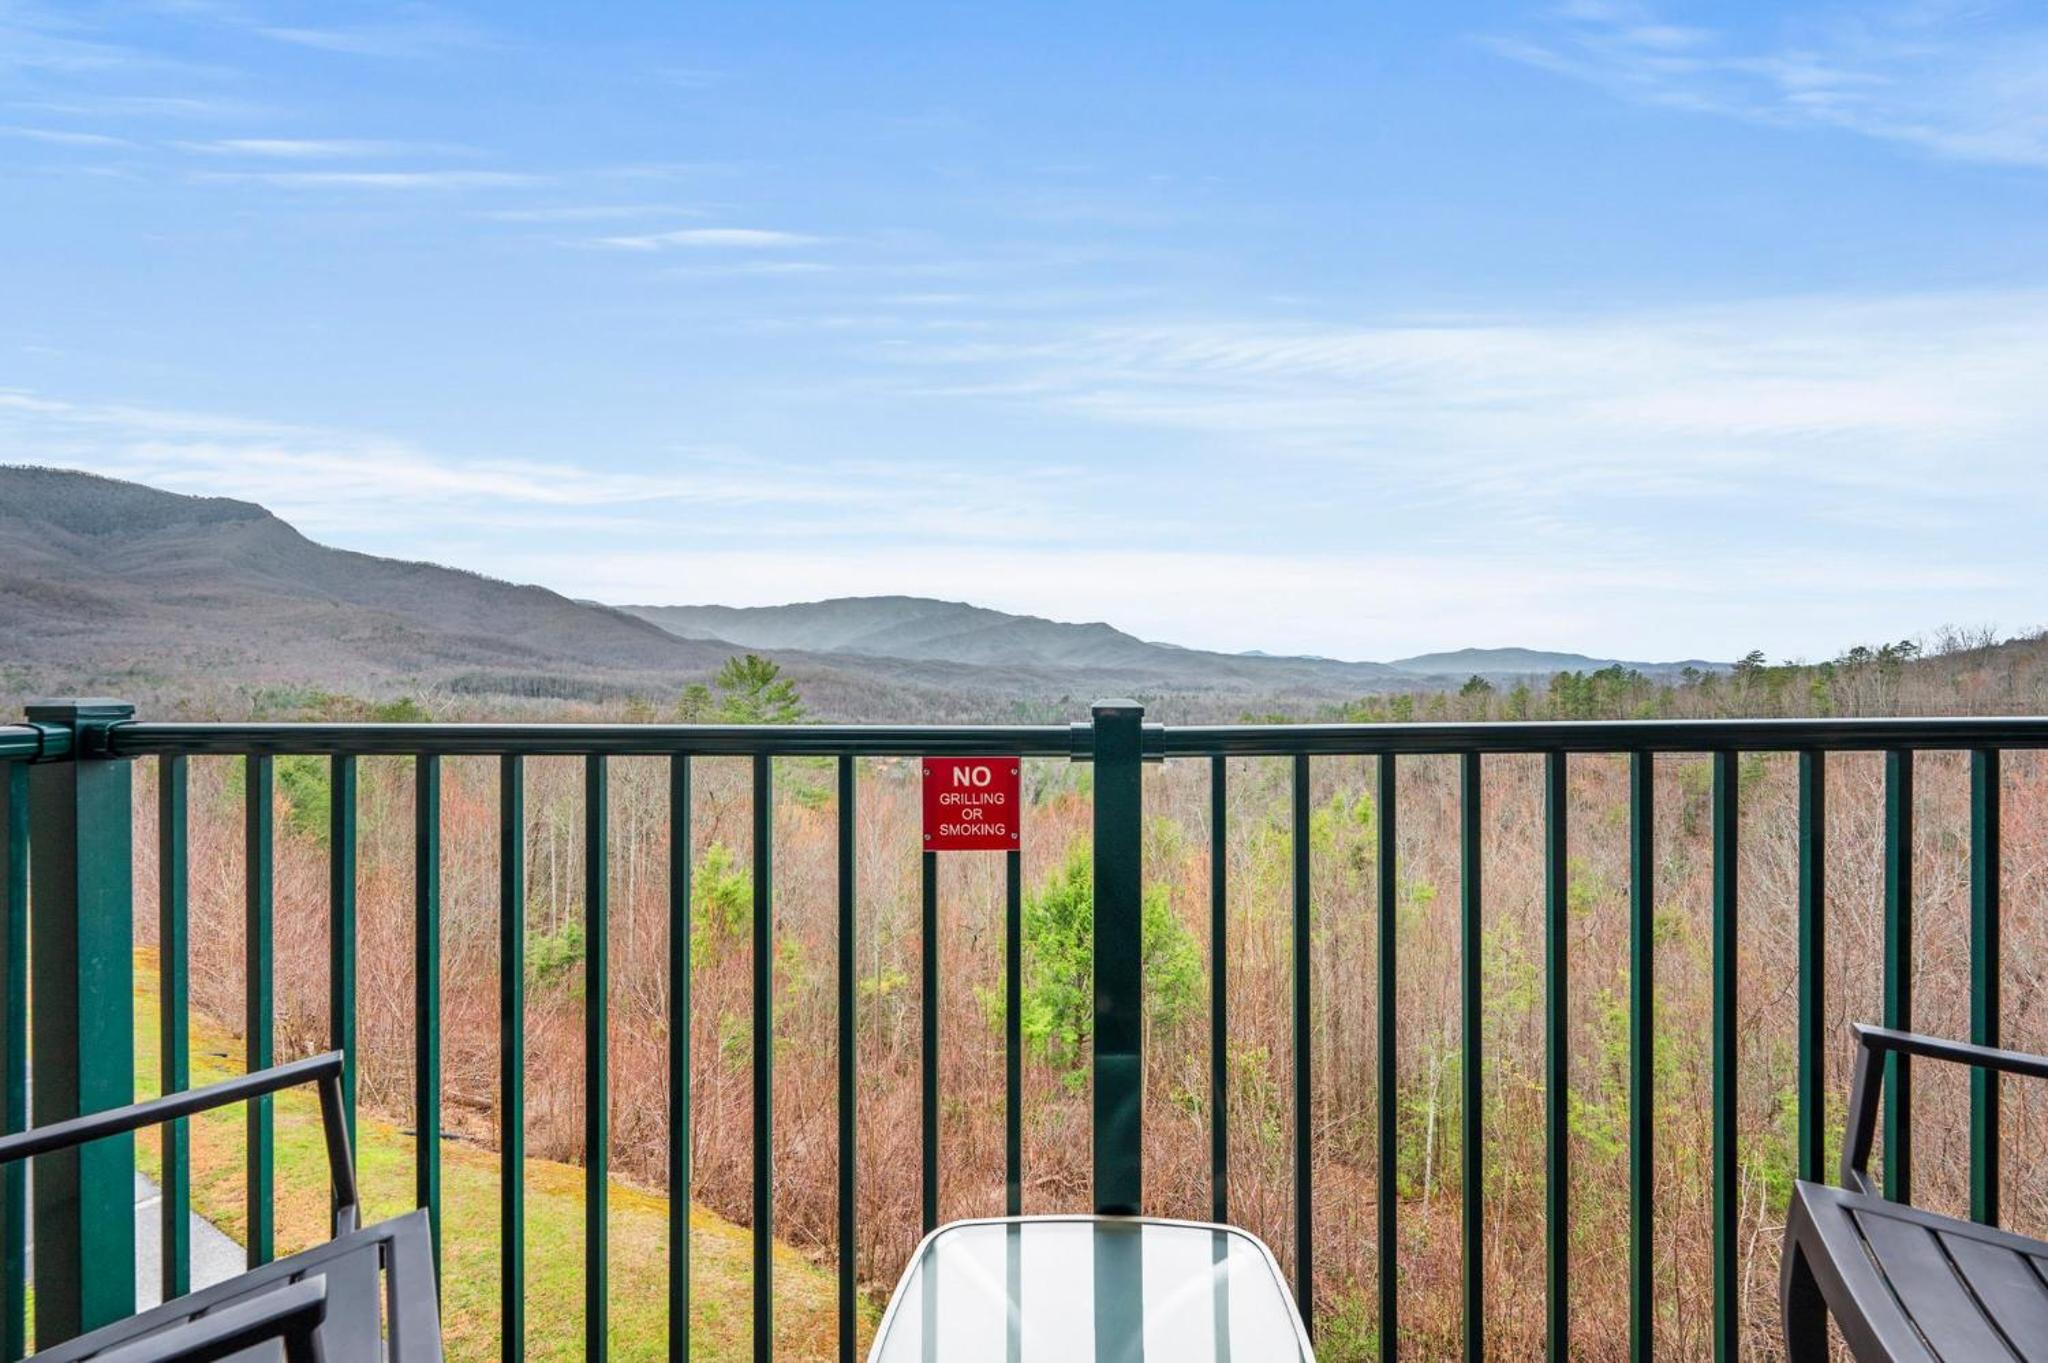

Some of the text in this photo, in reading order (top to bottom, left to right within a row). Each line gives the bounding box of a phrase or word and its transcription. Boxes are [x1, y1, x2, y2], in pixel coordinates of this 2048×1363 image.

[953, 766, 992, 787] NO
[939, 793, 1005, 805] GRILLING
[961, 808, 983, 820] OR
[939, 823, 1006, 836] SMOKING
